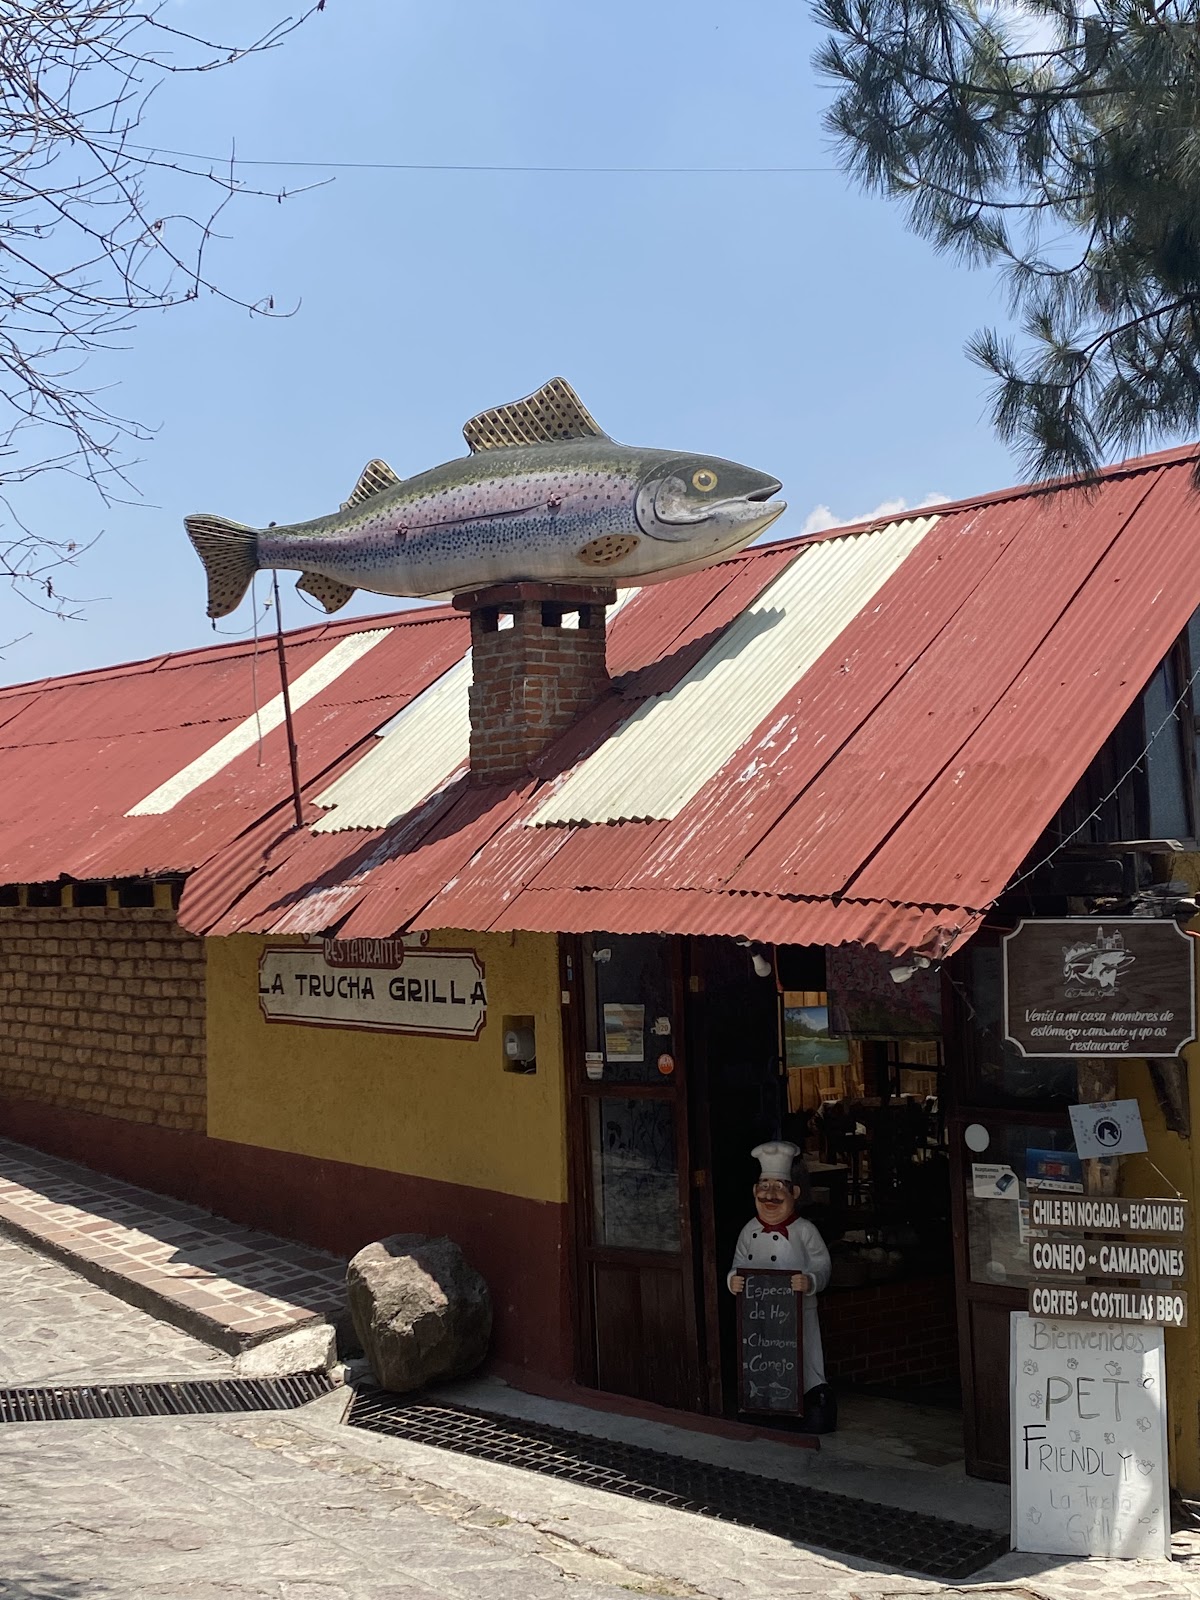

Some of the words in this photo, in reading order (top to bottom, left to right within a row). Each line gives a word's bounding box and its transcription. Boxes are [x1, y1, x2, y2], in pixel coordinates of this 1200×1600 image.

[325, 938, 402, 964] RESTAURANTE
[258, 973, 285, 995] LA
[295, 974, 375, 1000] TRUCHA
[389, 977, 487, 1006] GRILLA
[1025, 1008, 1057, 1022] Venid
[1056, 1012, 1065, 1021] a
[1081, 1012, 1106, 1022] casa
[1159, 1010, 1174, 1022] de
[1069, 1039, 1130, 1051] restauraré
[1138, 1027, 1153, 1040] yo
[1154, 1027, 1168, 1037] os
[1033, 1200, 1060, 1225] CHILE
[1062, 1201, 1075, 1226] EN
[1078, 1202, 1120, 1228] NOGADA
[1130, 1205, 1184, 1231] ESCAMOLES
[1033, 1243, 1086, 1274] CONEJO
[1100, 1246, 1184, 1276] CAMARONES
[749, 1301, 765, 1319] de
[770, 1304, 790, 1324] Hoy
[1033, 1288, 1078, 1316] CORTES
[1091, 1292, 1154, 1320] COSTILLAS
[1156, 1296, 1184, 1325] BBQ
[749, 1353, 794, 1377] Conejo
[1045, 1375, 1130, 1422] PET
[1023, 1425, 1133, 1481] FRIENDLY
